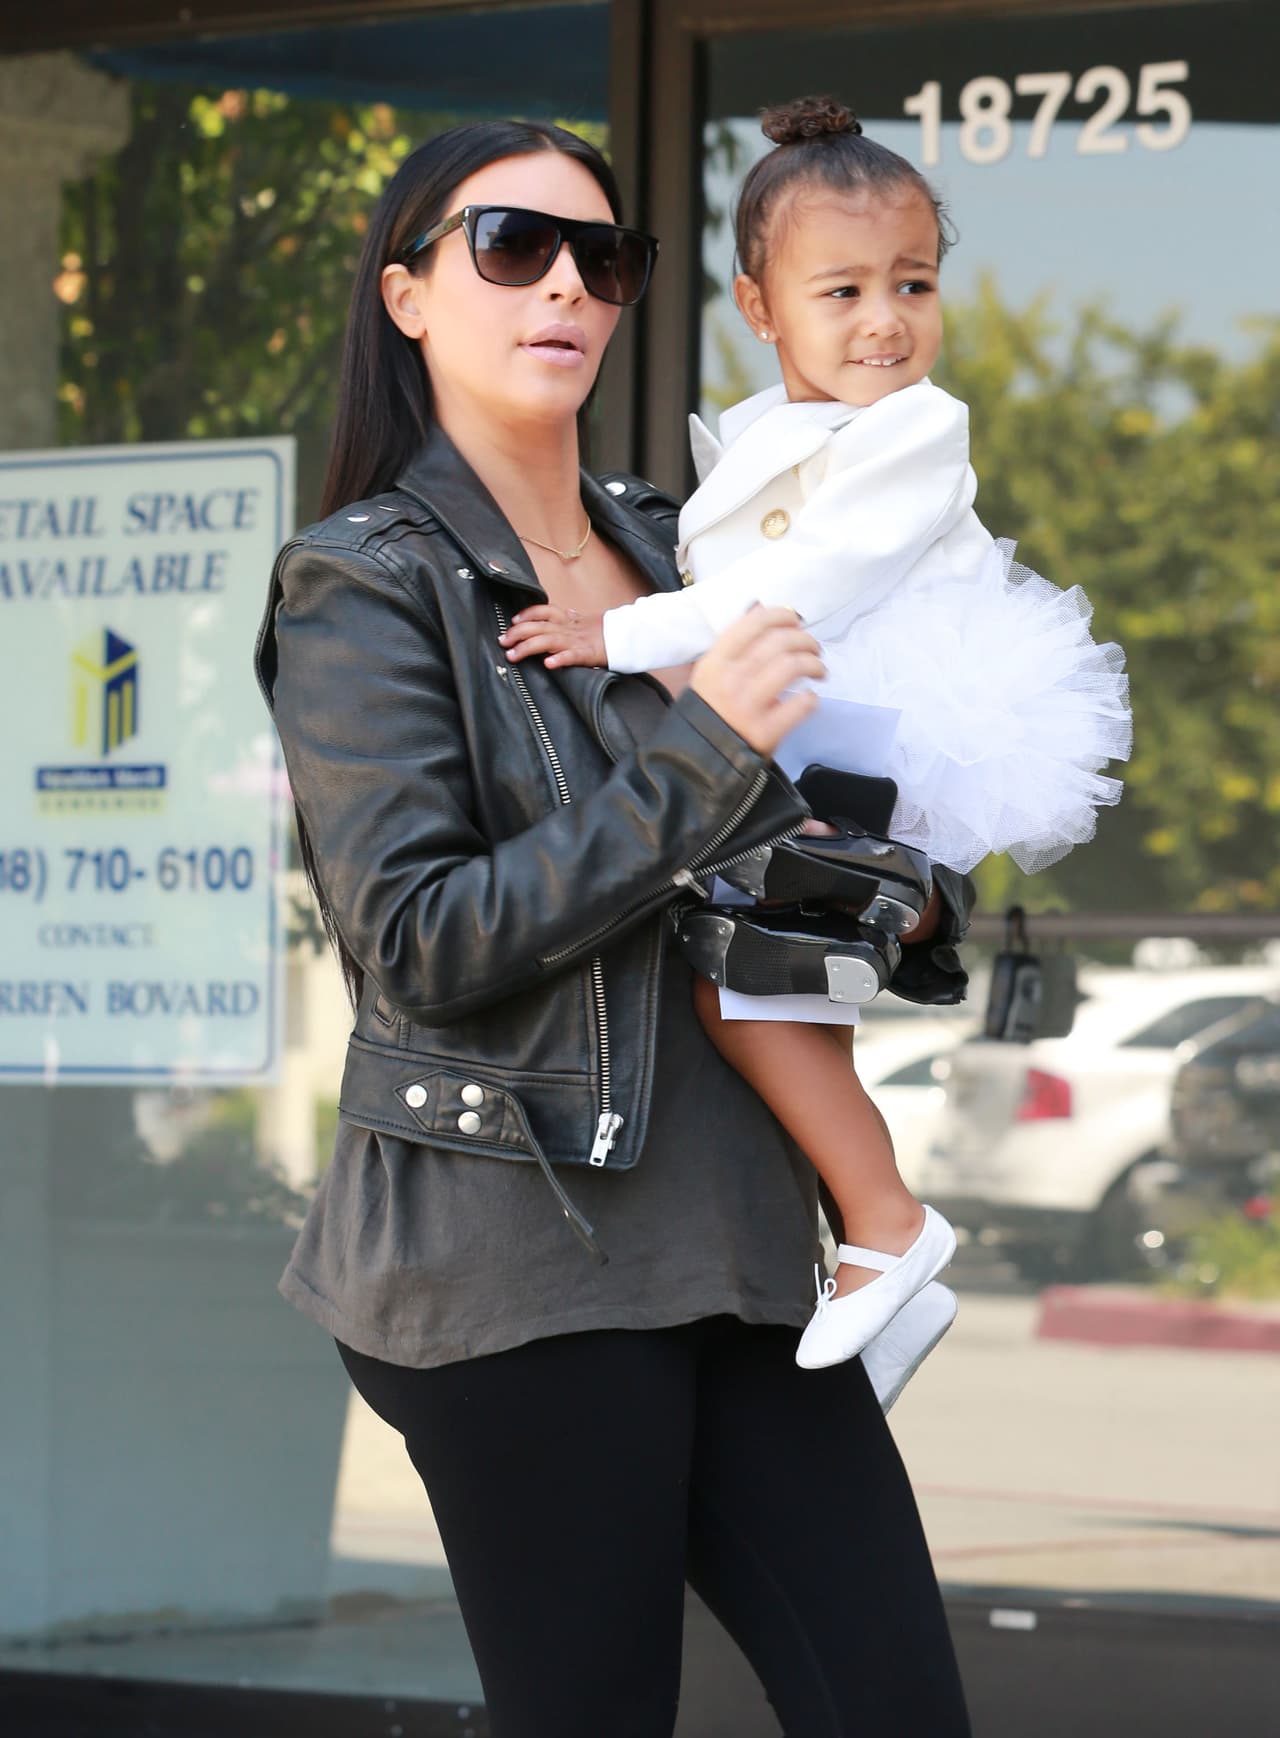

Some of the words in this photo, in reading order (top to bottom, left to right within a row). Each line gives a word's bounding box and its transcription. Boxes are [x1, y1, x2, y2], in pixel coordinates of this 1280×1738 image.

[903, 60, 1192, 165] 18725
[123, 487, 259, 536] SPACE
[38, 922, 155, 948] CONTACT
[107, 980, 260, 1016] BOVARD
